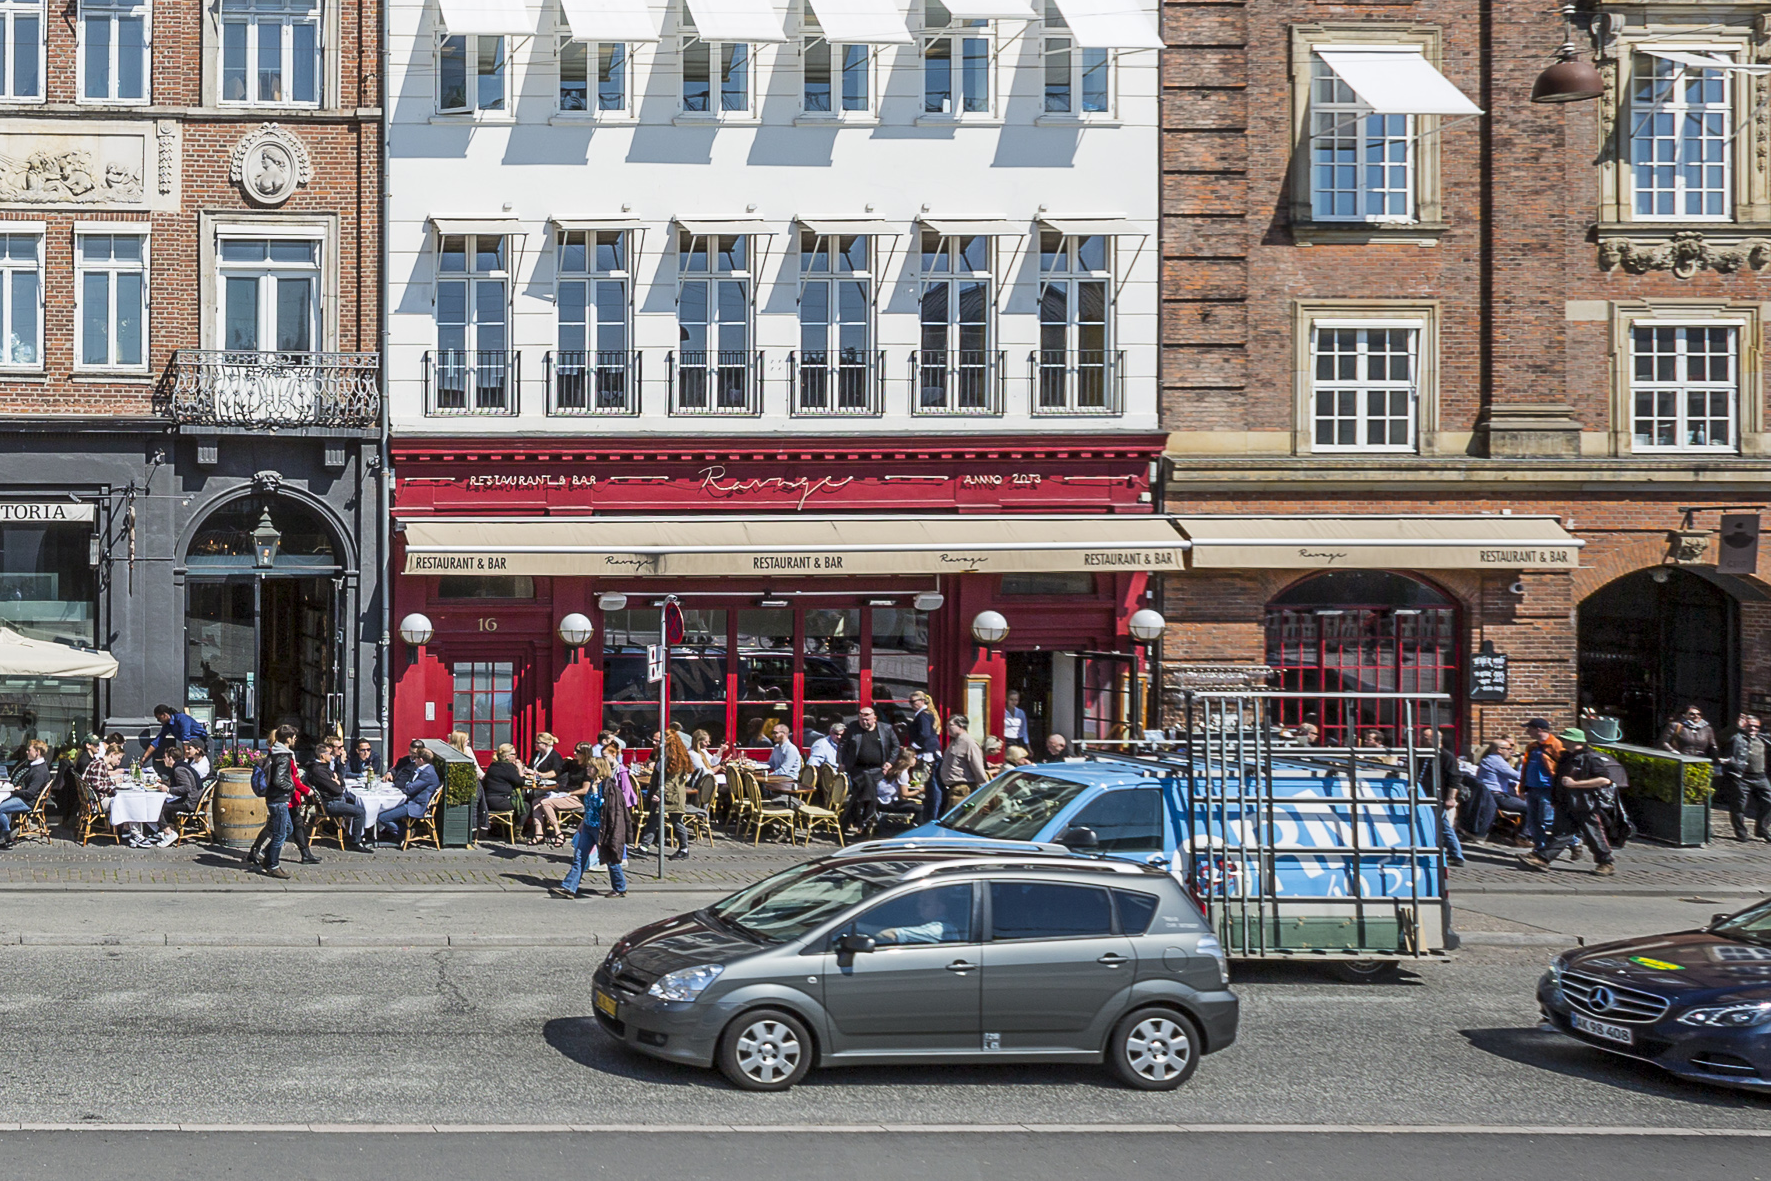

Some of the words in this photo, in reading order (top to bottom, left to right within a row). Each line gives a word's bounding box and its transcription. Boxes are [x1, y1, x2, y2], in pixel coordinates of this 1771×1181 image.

[469, 475, 551, 486] RESTAURANT
[572, 475, 597, 485] BAR
[415, 557, 475, 570] RESTAURANT
[477, 557, 485, 569] &
[488, 557, 507, 569] BAR
[753, 556, 812, 569] RESTAURANT
[814, 556, 821, 569] &
[823, 556, 843, 569] BAR
[1084, 553, 1141, 566] RESTAURANT
[1144, 553, 1152, 566] &
[1154, 552, 1173, 565] BAR
[1479, 550, 1536, 564] RESTAURANT
[1539, 551, 1547, 564] &
[1549, 550, 1568, 563] BAR
[477, 617, 498, 631] 16
